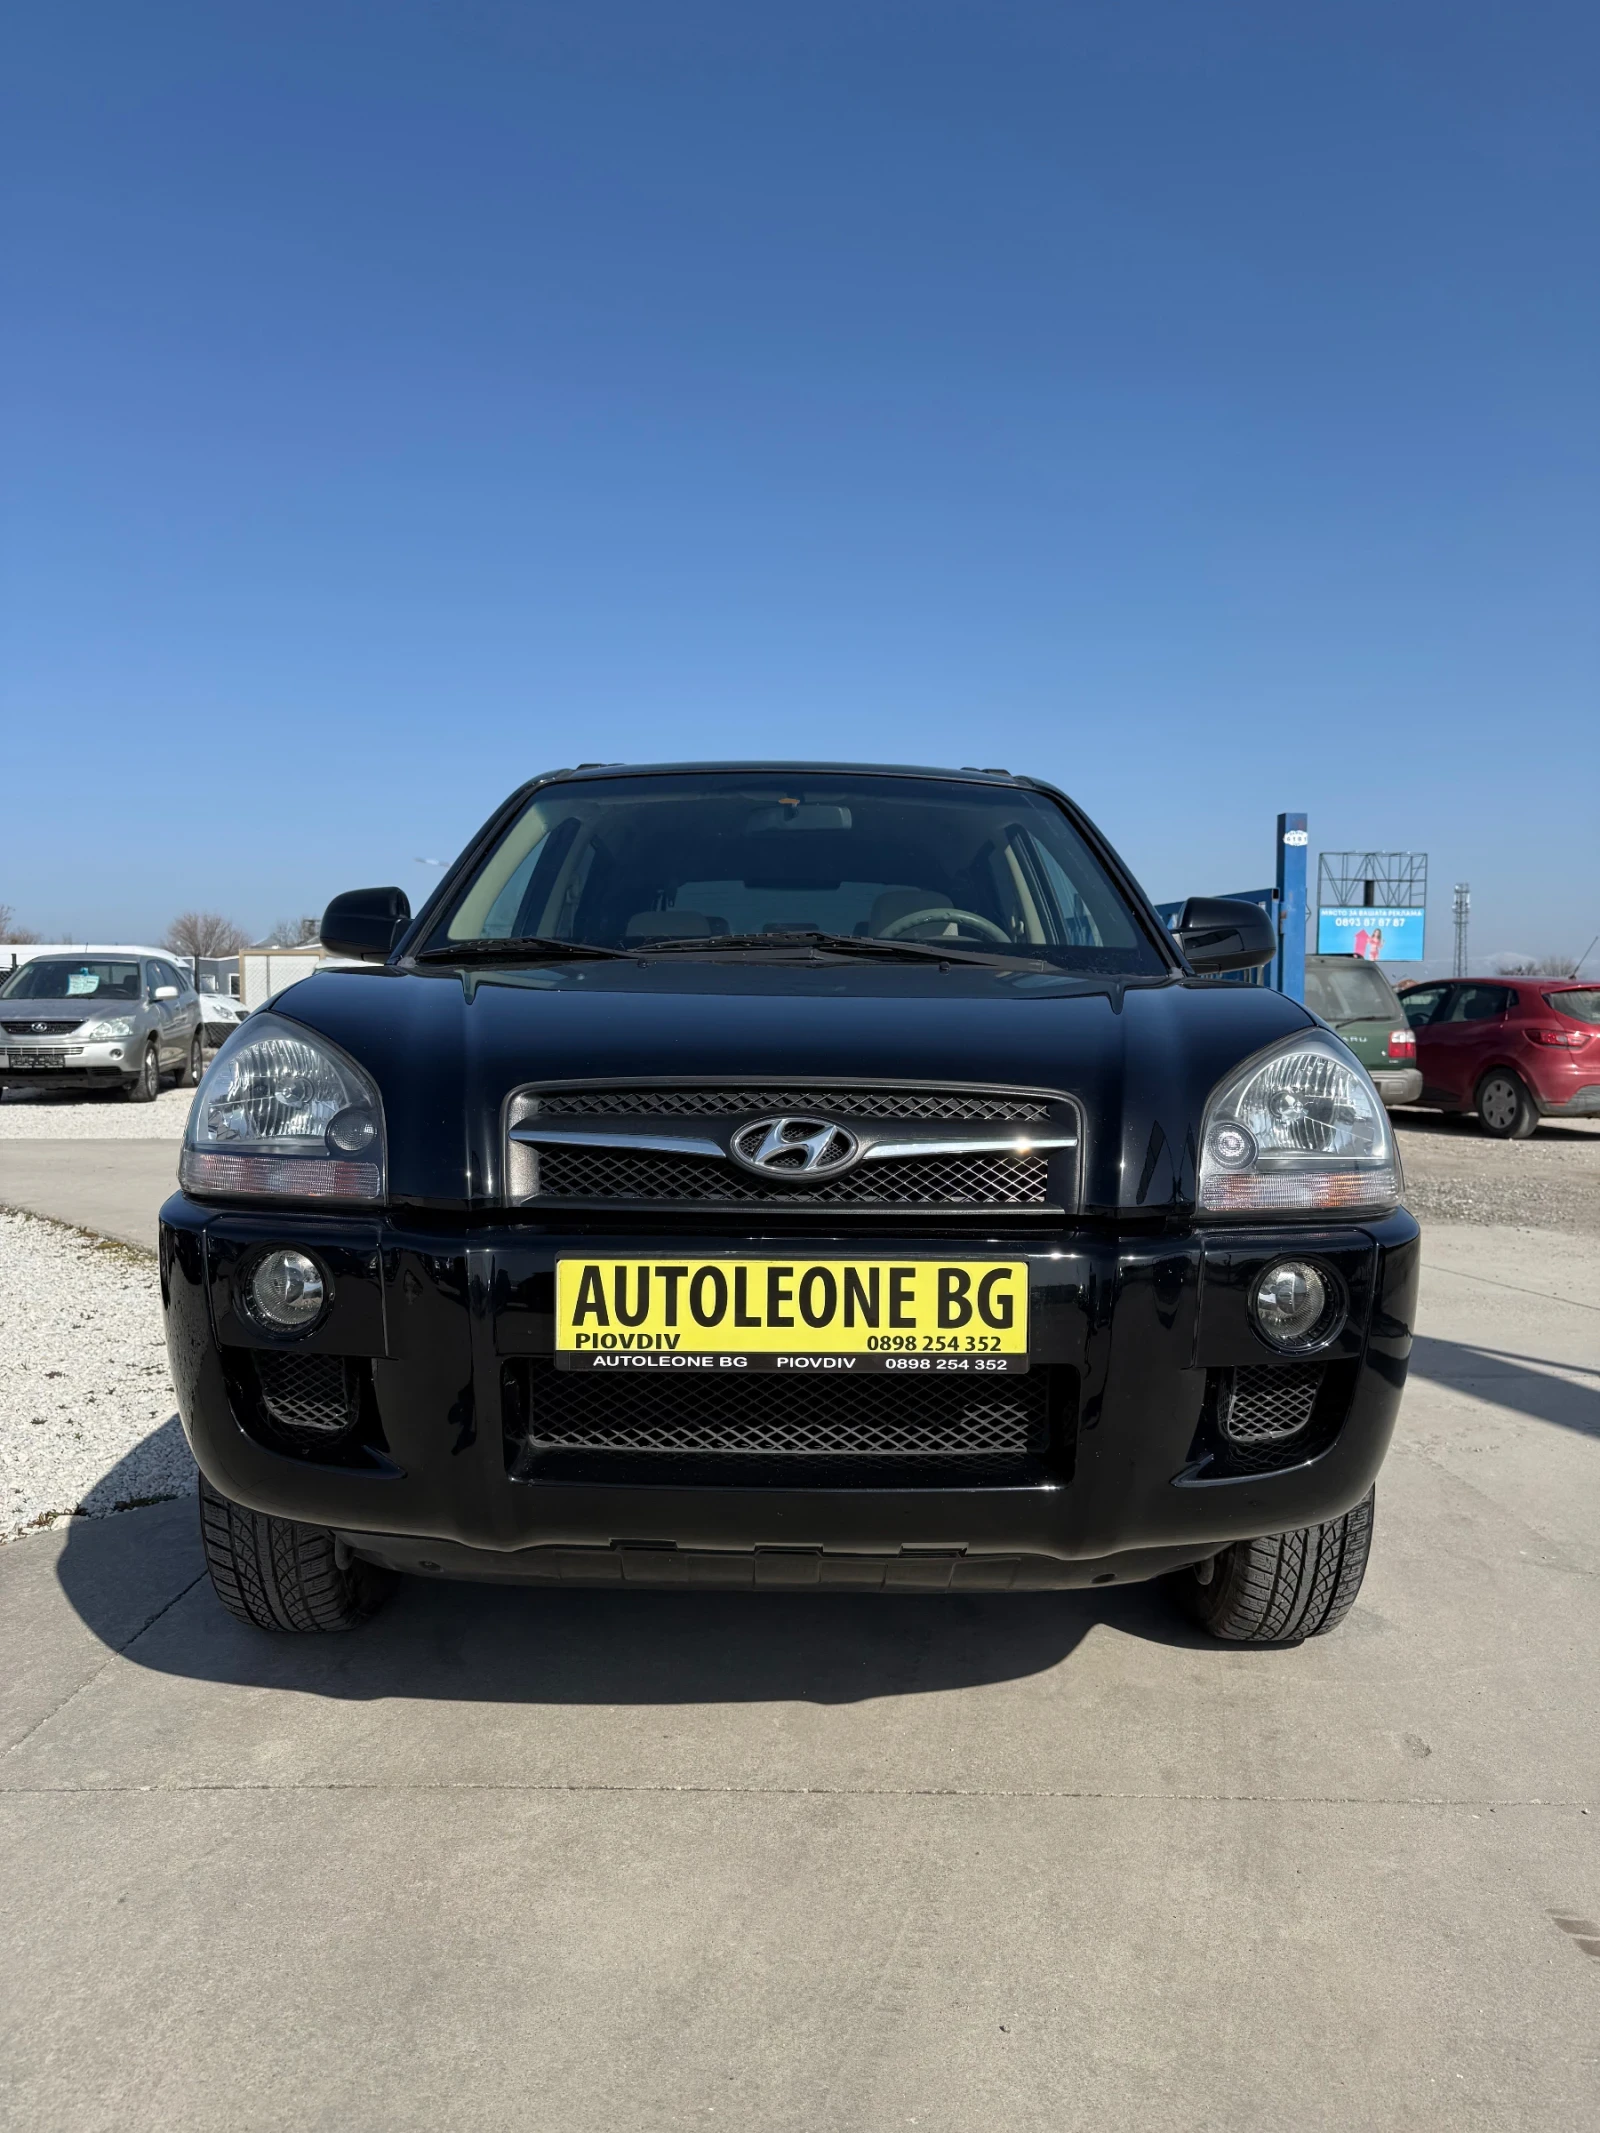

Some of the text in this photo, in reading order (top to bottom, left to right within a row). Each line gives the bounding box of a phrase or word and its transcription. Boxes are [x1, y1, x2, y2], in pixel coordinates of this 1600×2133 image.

[1335, 918, 1406, 927] 0893 87 87 87
[571, 1264, 1014, 1330] AUTOLEONE BG
[867, 1335, 1002, 1352] 0898 254 352
[592, 1355, 1008, 1371] AUTOLEONE BG PIOVDIV 0898 254 352
